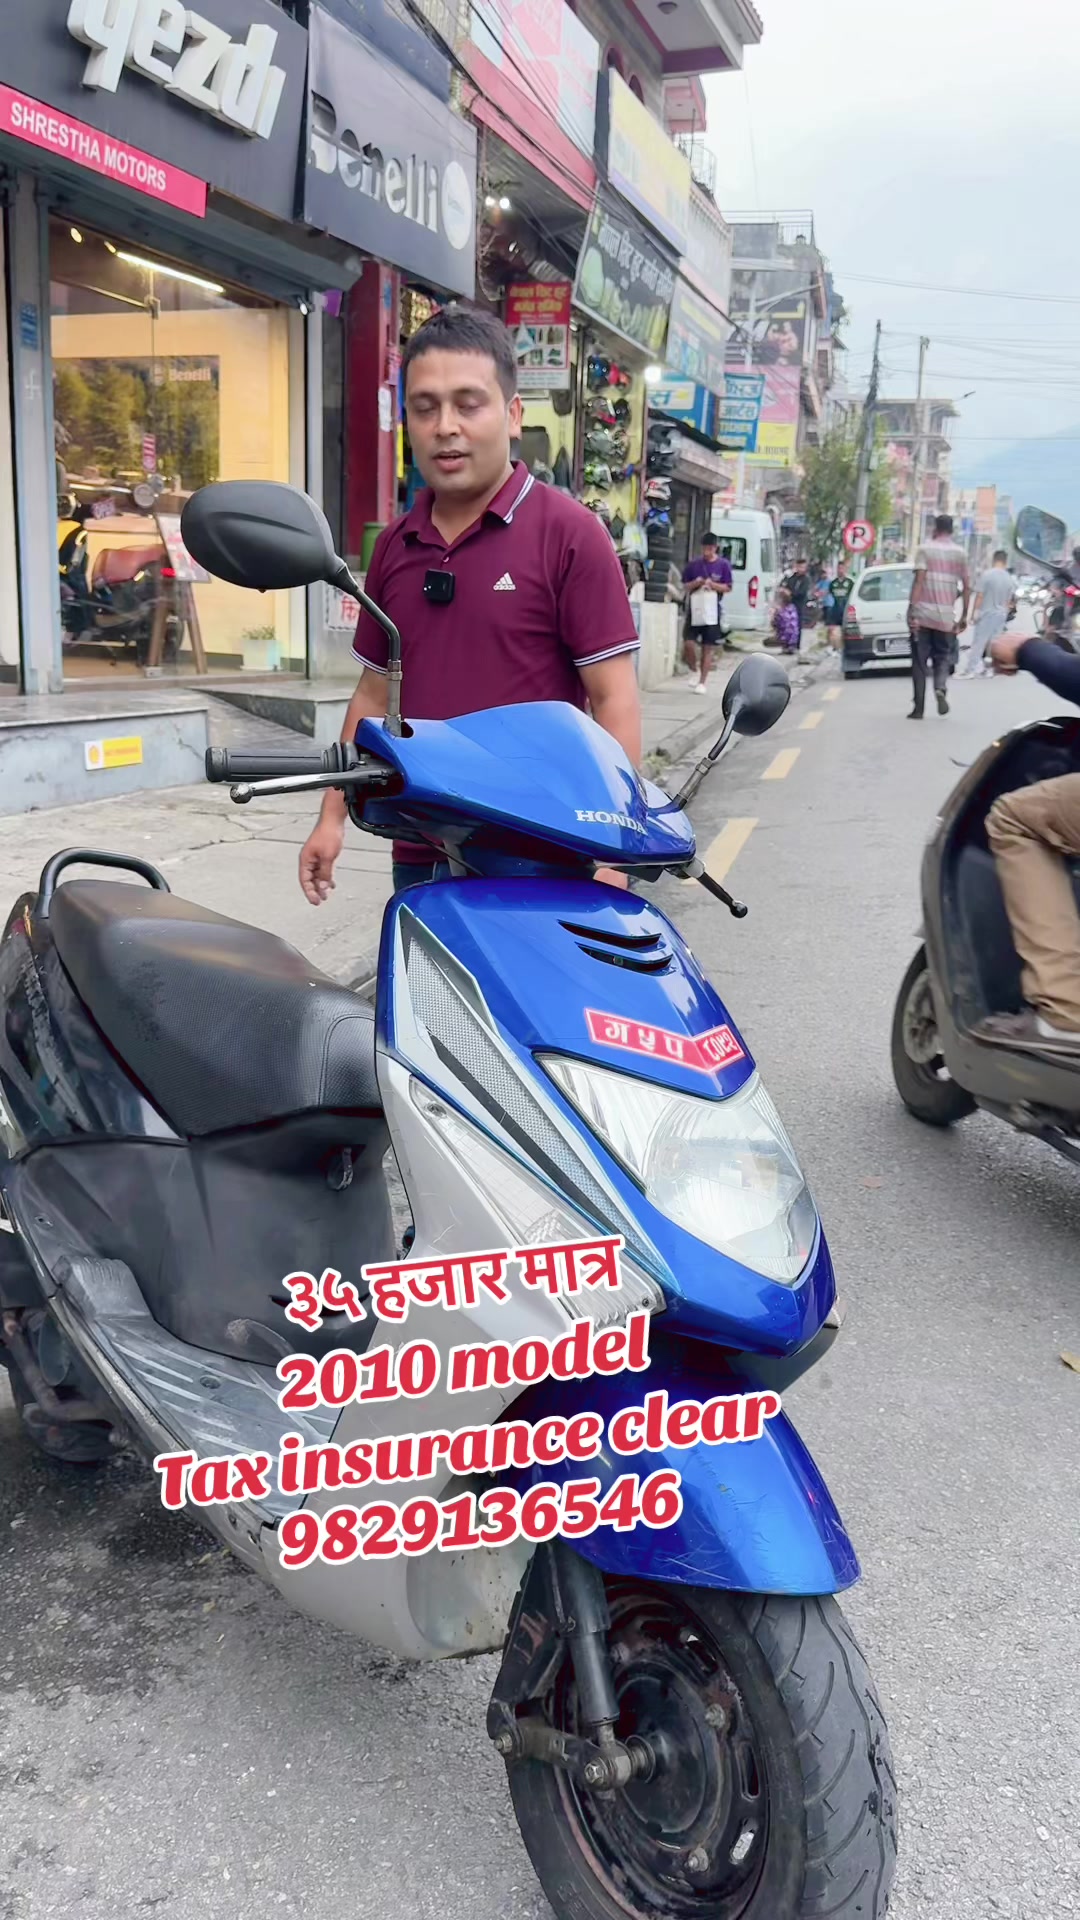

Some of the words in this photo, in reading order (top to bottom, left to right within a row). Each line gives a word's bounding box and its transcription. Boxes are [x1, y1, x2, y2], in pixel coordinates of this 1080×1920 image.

[11, 102, 100, 163] SHRESTHA
[104, 144, 167, 191] MOTORS
[311, 90, 438, 233] Benelli
[852, 526, 866, 545] P
[574, 809, 648, 836] HONDA
